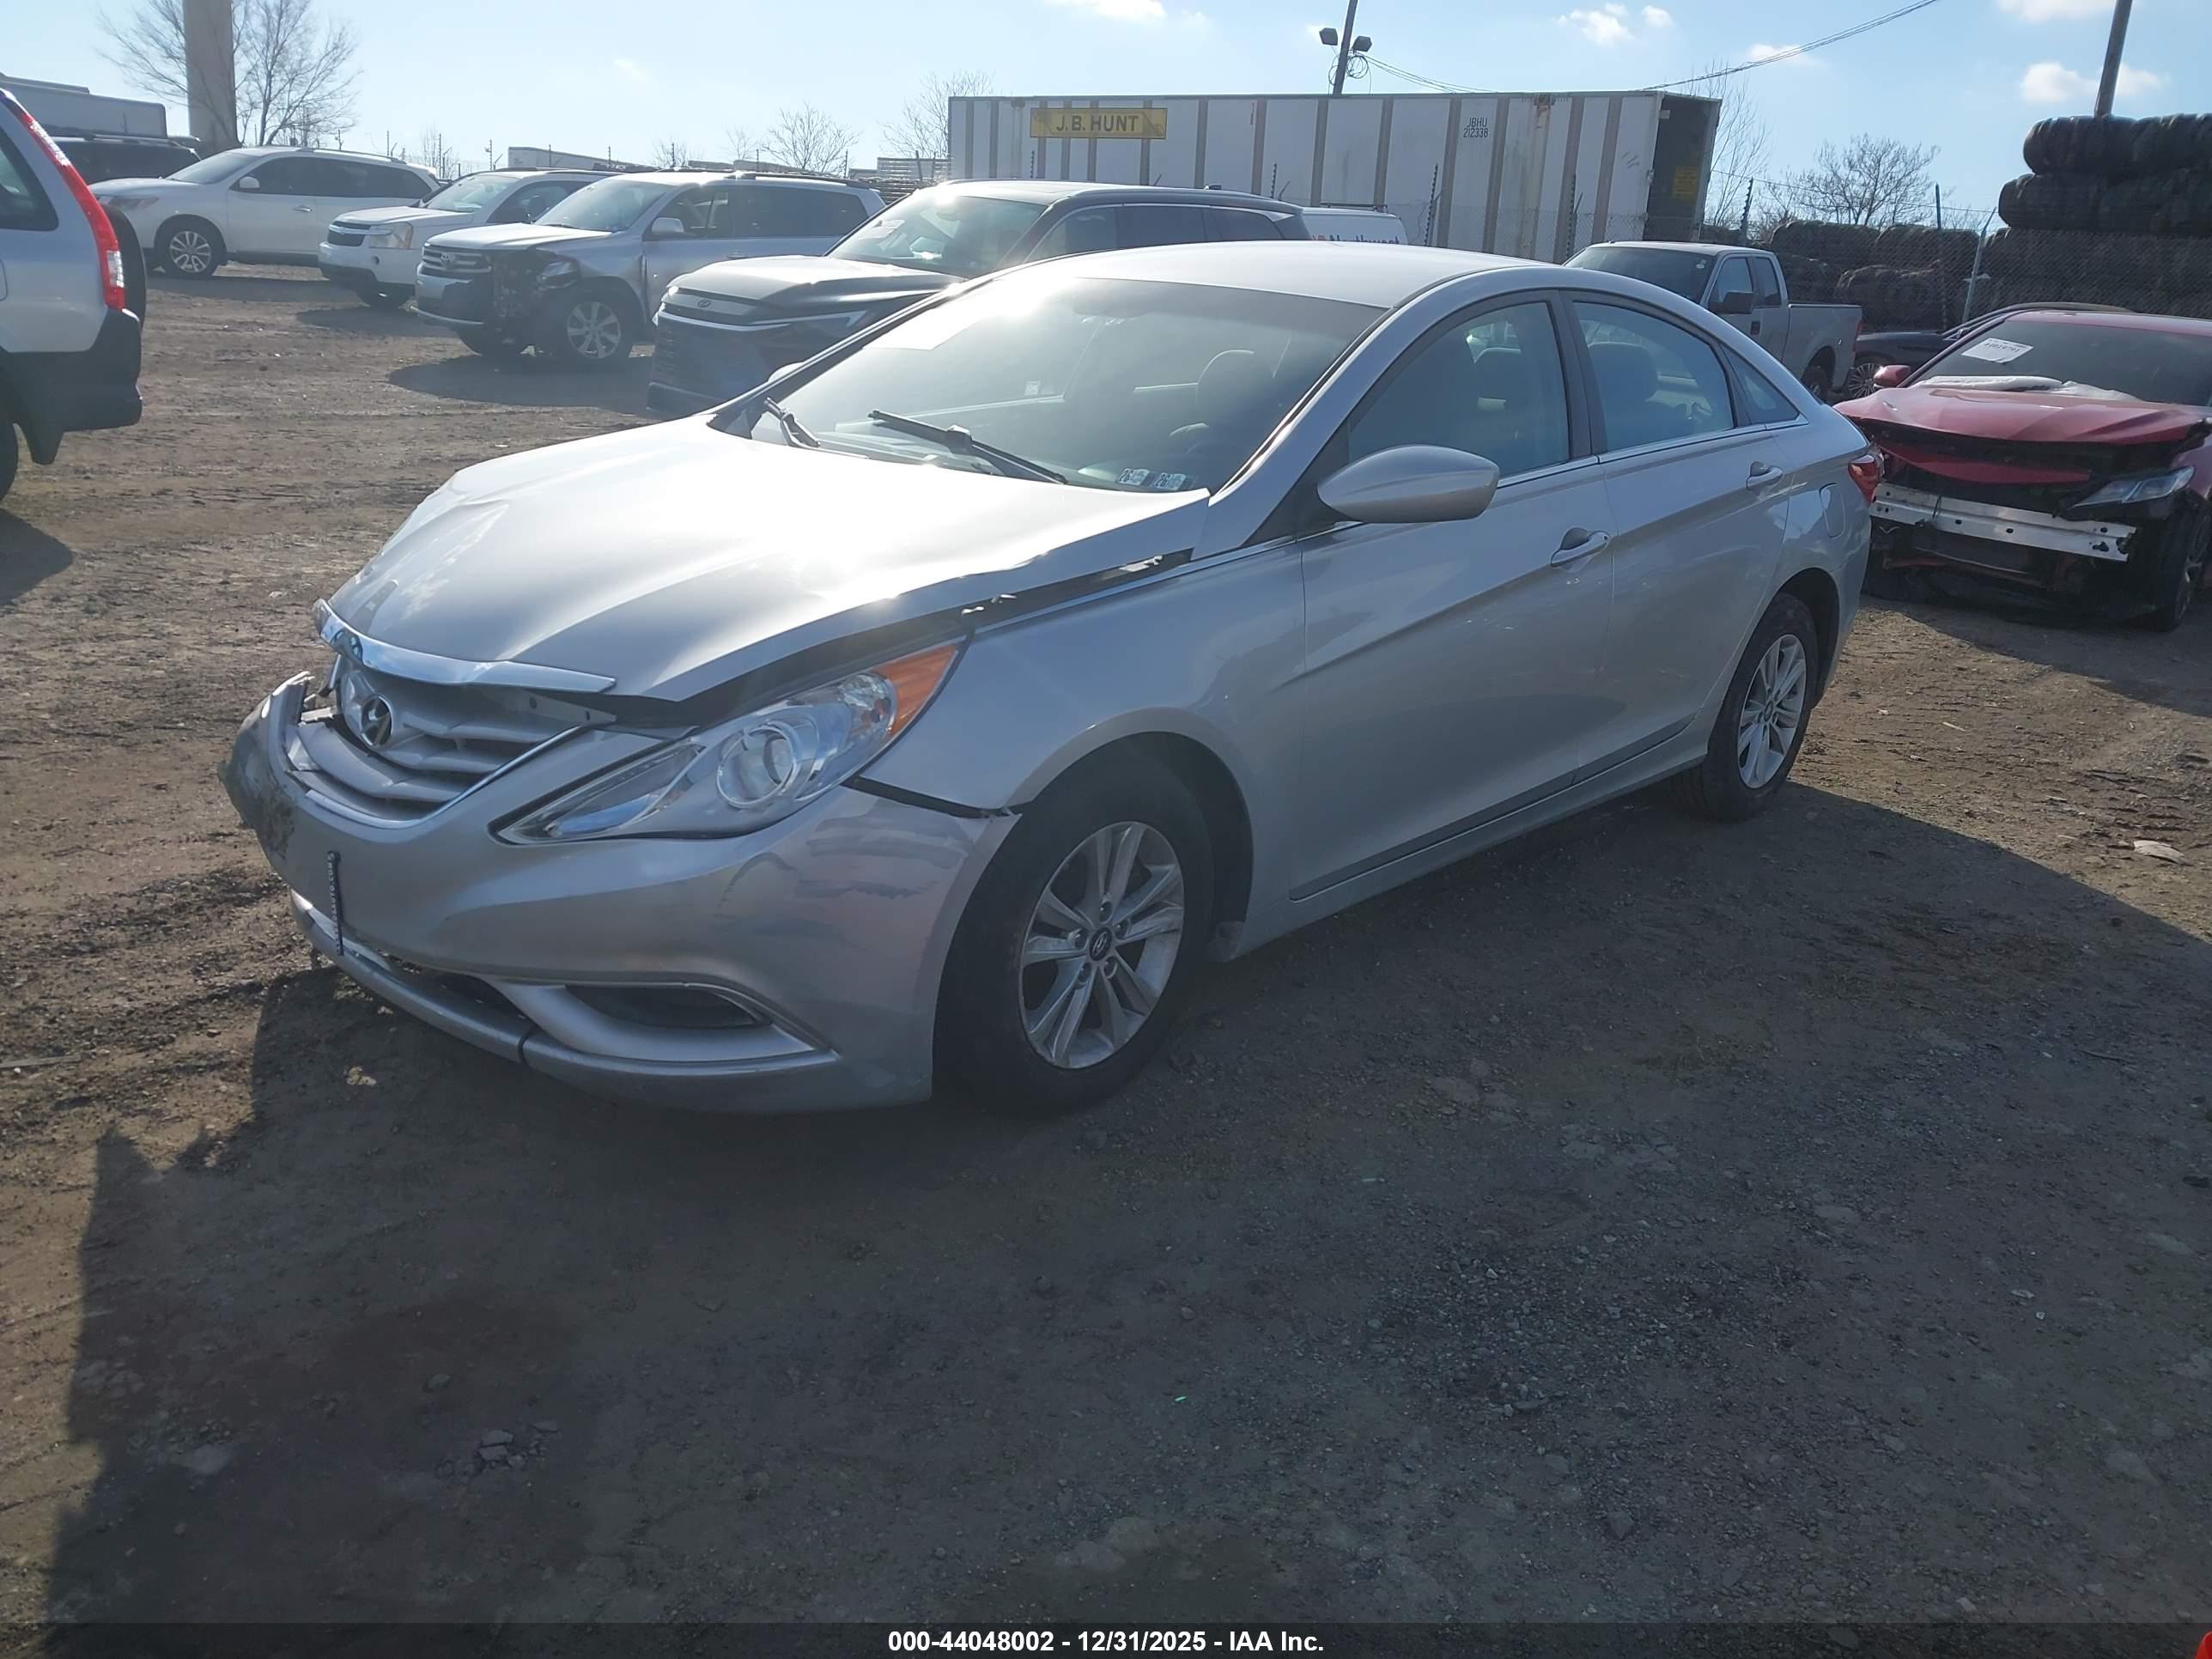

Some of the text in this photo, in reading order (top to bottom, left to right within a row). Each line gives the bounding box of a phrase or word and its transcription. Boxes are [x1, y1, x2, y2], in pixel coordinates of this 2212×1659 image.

[1056, 115, 1139, 131] J.B. HUNT
[1467, 117, 1487, 128] JBHU
[1463, 128, 1488, 137] 212338
